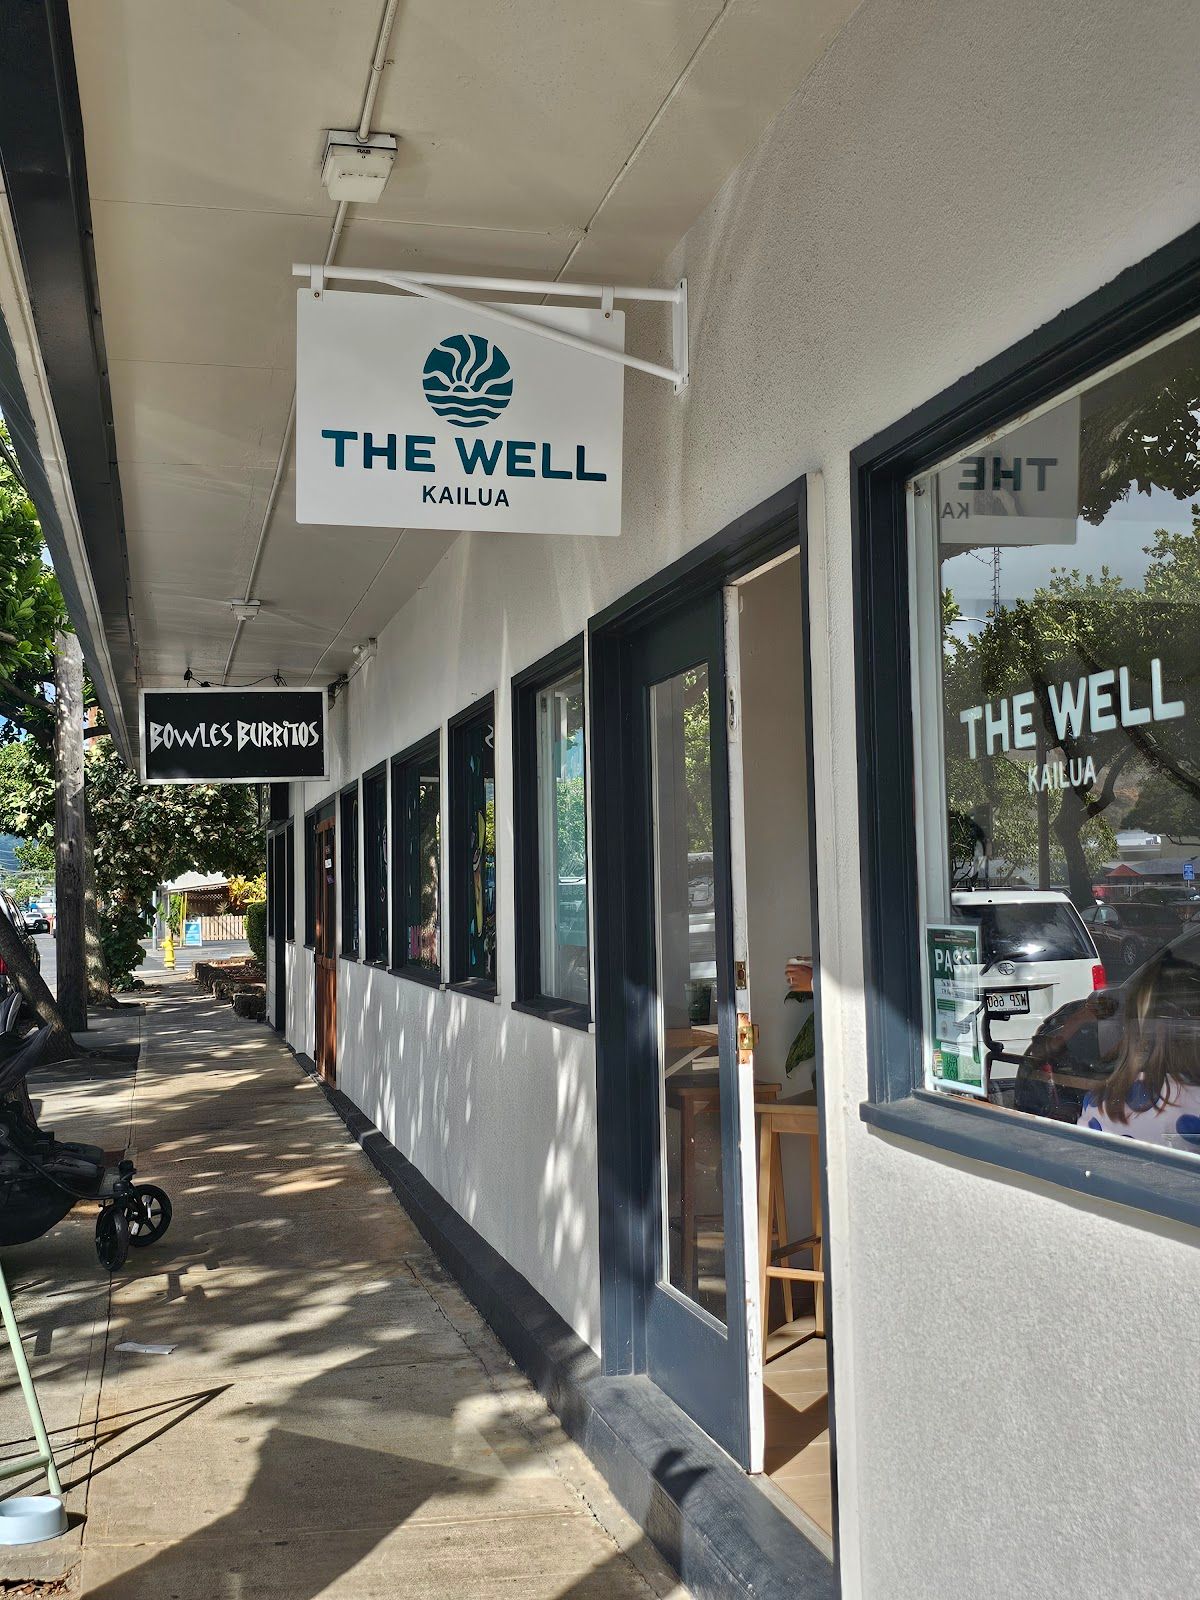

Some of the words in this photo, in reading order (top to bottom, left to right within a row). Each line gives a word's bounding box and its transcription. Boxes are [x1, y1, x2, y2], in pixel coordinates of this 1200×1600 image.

[322, 430, 435, 472] THE
[455, 437, 606, 481] WELL
[423, 485, 509, 507] KAILUA
[960, 690, 1037, 759] THE
[1048, 658, 1185, 740] WELL
[149, 720, 232, 753] BOWLES
[236, 719, 320, 753] BURRITOS
[1027, 756, 1097, 794] KAILUA
[935, 949, 972, 972] PASS
